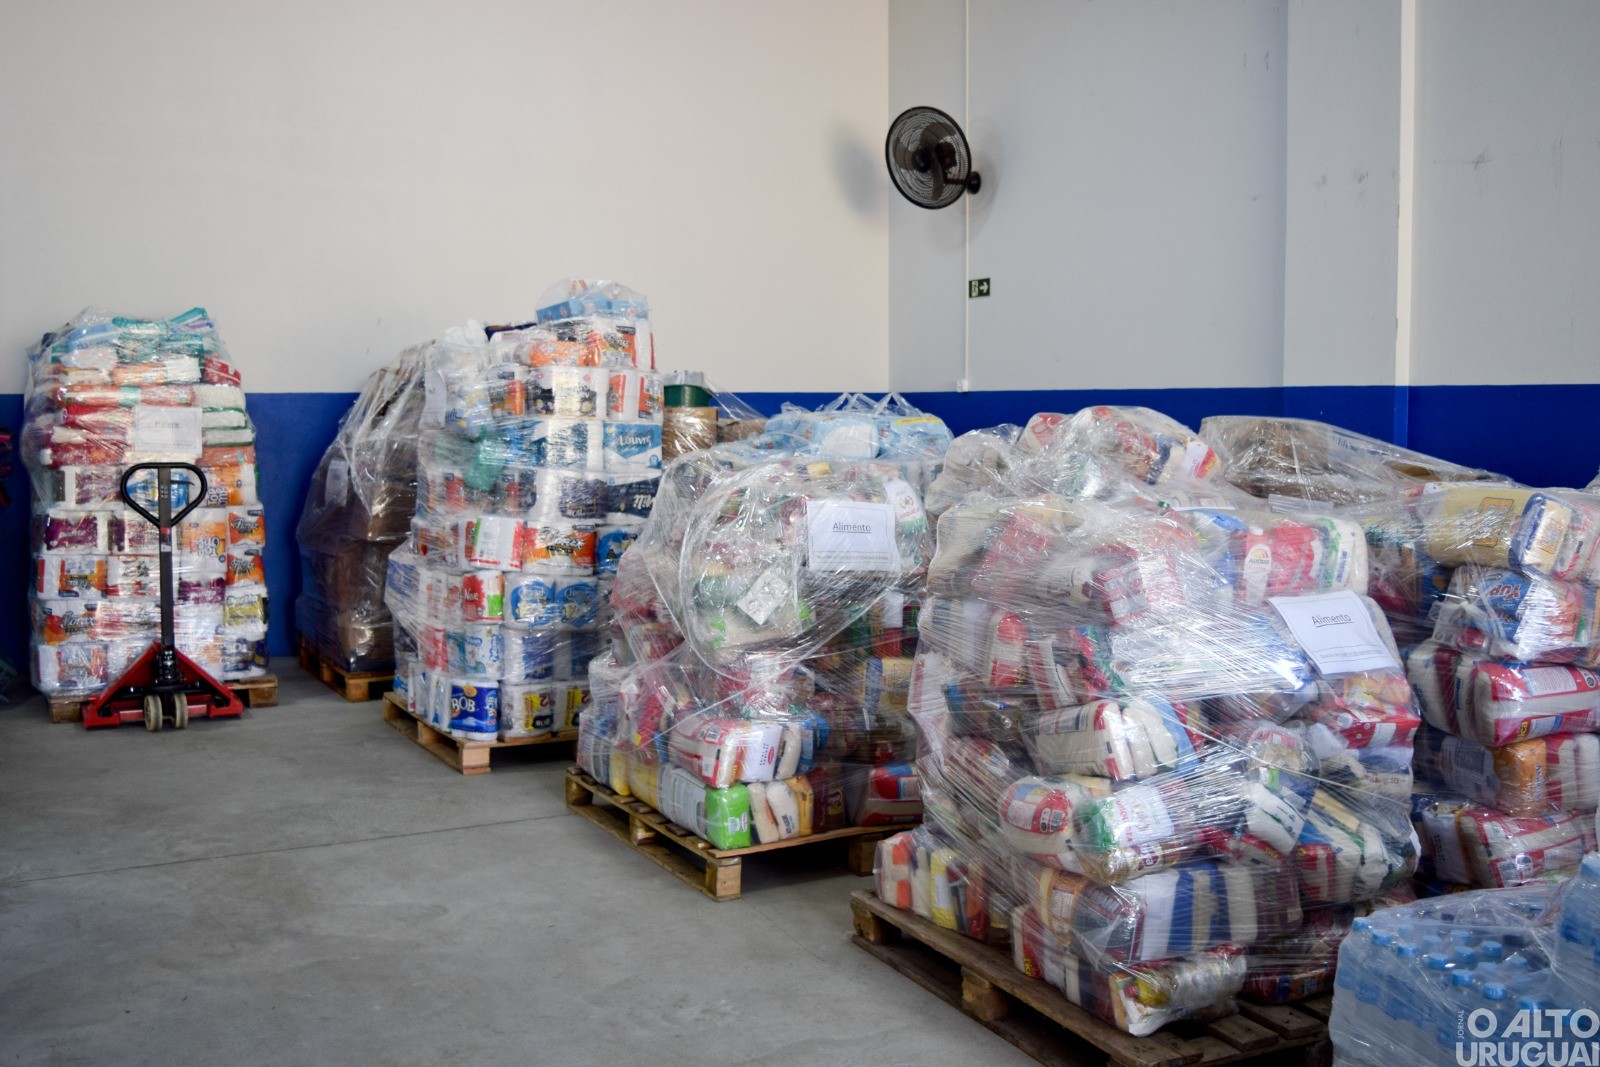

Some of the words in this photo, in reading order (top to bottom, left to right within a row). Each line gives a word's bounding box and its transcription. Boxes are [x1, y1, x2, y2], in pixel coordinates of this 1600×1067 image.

[832, 522, 872, 533] Alimento
[1311, 613, 1353, 627] Alimento
[451, 696, 477, 713] BOB
